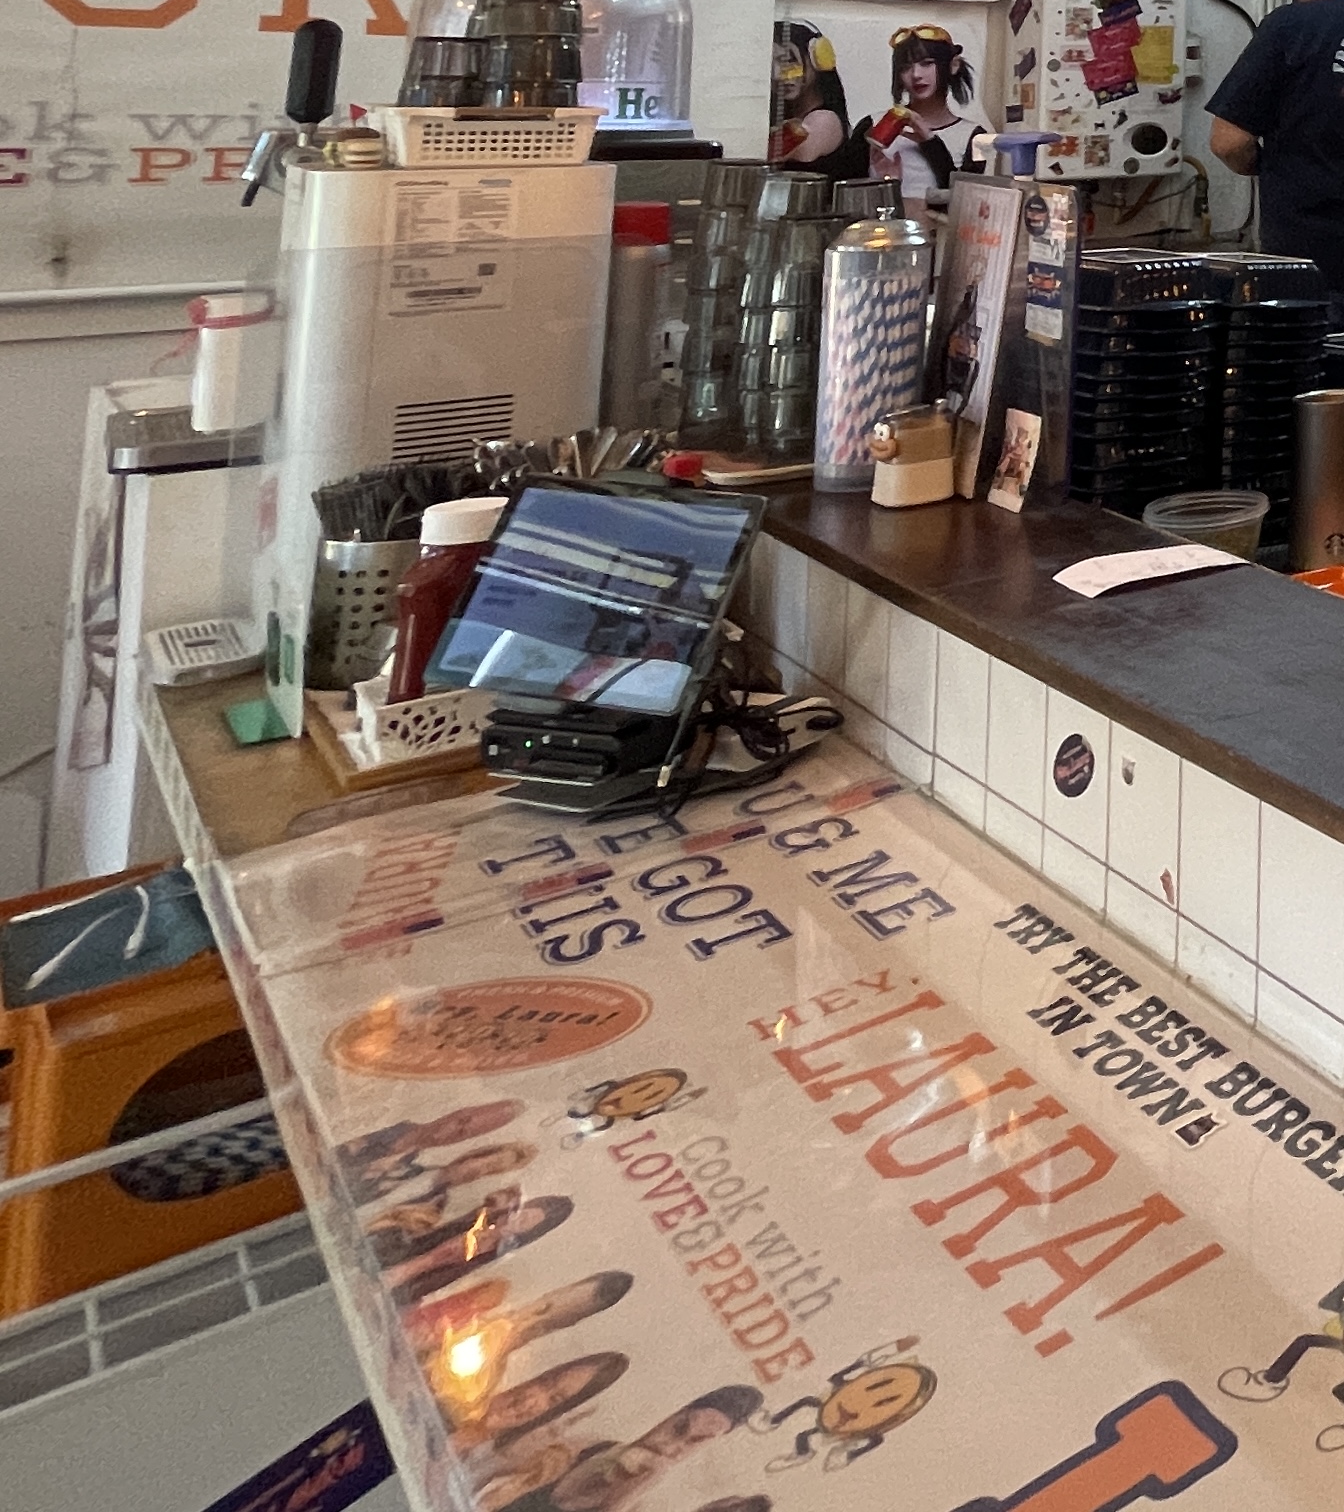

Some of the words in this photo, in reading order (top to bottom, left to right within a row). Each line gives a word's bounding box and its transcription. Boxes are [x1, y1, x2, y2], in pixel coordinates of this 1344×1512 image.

[632, 854, 795, 962] GOT
[807, 849, 957, 942] ME
[994, 903, 1074, 955] TRY
[1052, 947, 1141, 1009] THE
[1115, 996, 1231, 1073] BEST
[1025, 996, 1095, 1037] IN
[1073, 1030, 1207, 1128] TOWN
[675, 1133, 770, 1227] Cook
[745, 1221, 843, 1324] with
[773, 990, 1224, 1359] LAURA!
